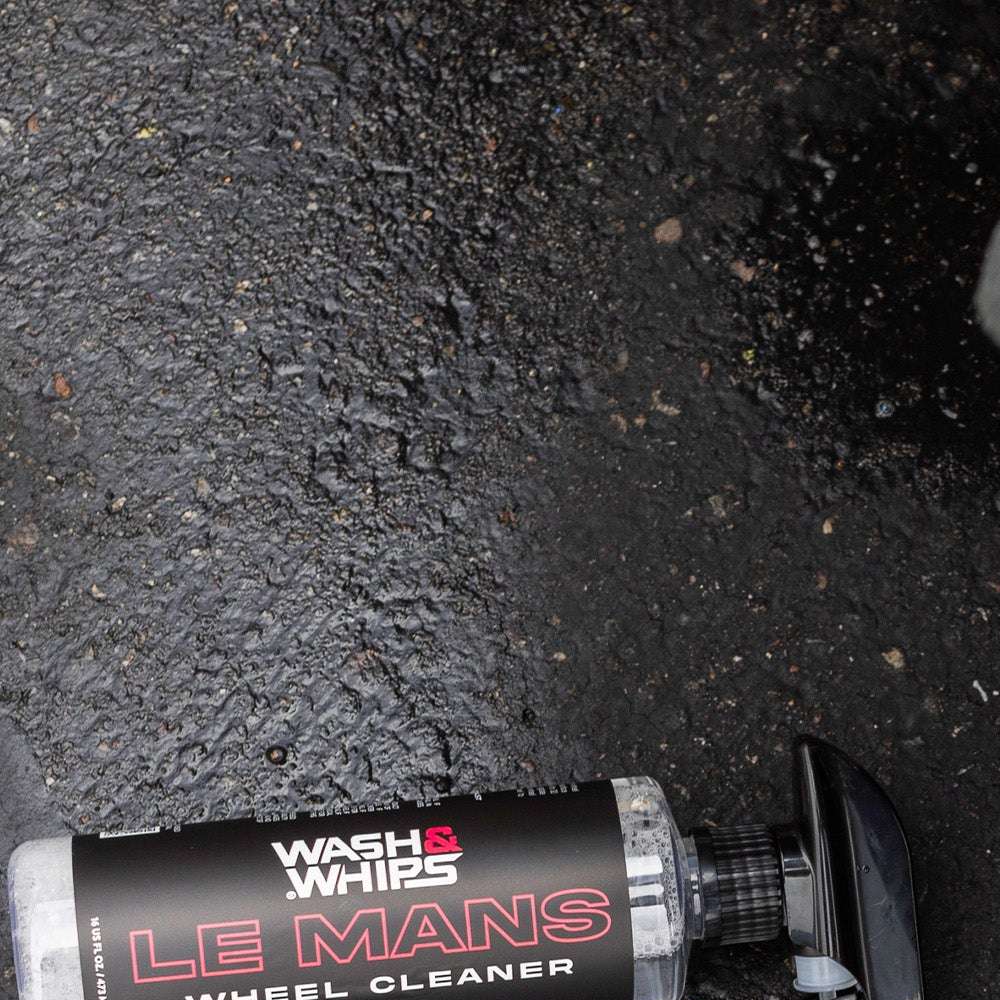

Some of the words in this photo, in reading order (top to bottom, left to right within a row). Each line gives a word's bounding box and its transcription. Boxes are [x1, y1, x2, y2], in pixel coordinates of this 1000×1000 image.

[285, 853, 463, 898] WHIPS
[90, 917, 99, 927] 16
[91, 928, 101, 942] US
[129, 919, 264, 984] LE
[294, 888, 612, 967] MANS
[93, 943, 103, 955] FL
[94, 955, 104, 972] OZ
[369, 958, 574, 994] CLEANER
[96, 978, 107, 995] 473
